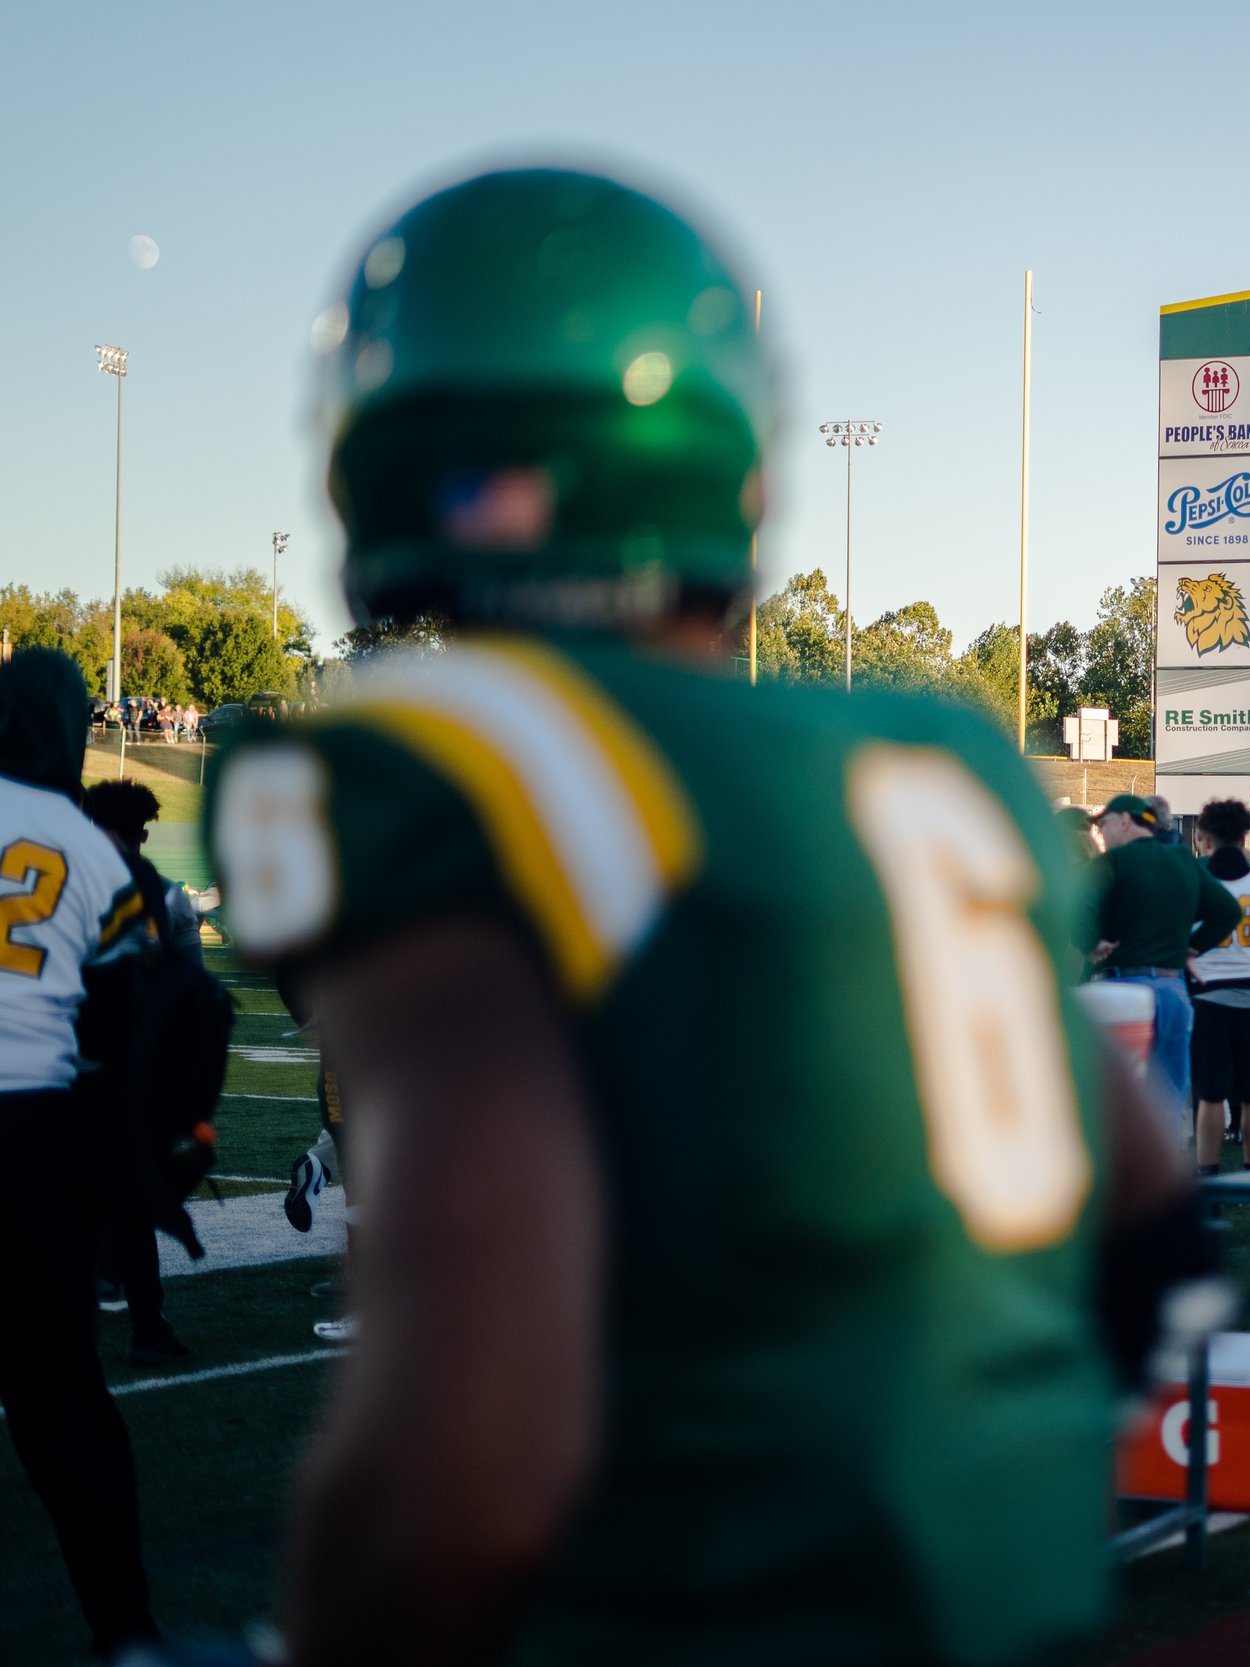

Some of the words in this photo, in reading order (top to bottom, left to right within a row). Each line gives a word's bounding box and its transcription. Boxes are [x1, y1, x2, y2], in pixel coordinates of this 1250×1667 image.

[1165, 425, 1225, 442] PEOPLE'S
[1210, 441, 1219, 452] of
[1186, 536, 1219, 545] SINCE
[1224, 534, 1249, 545] 1898
[1165, 709, 1194, 725] RE
